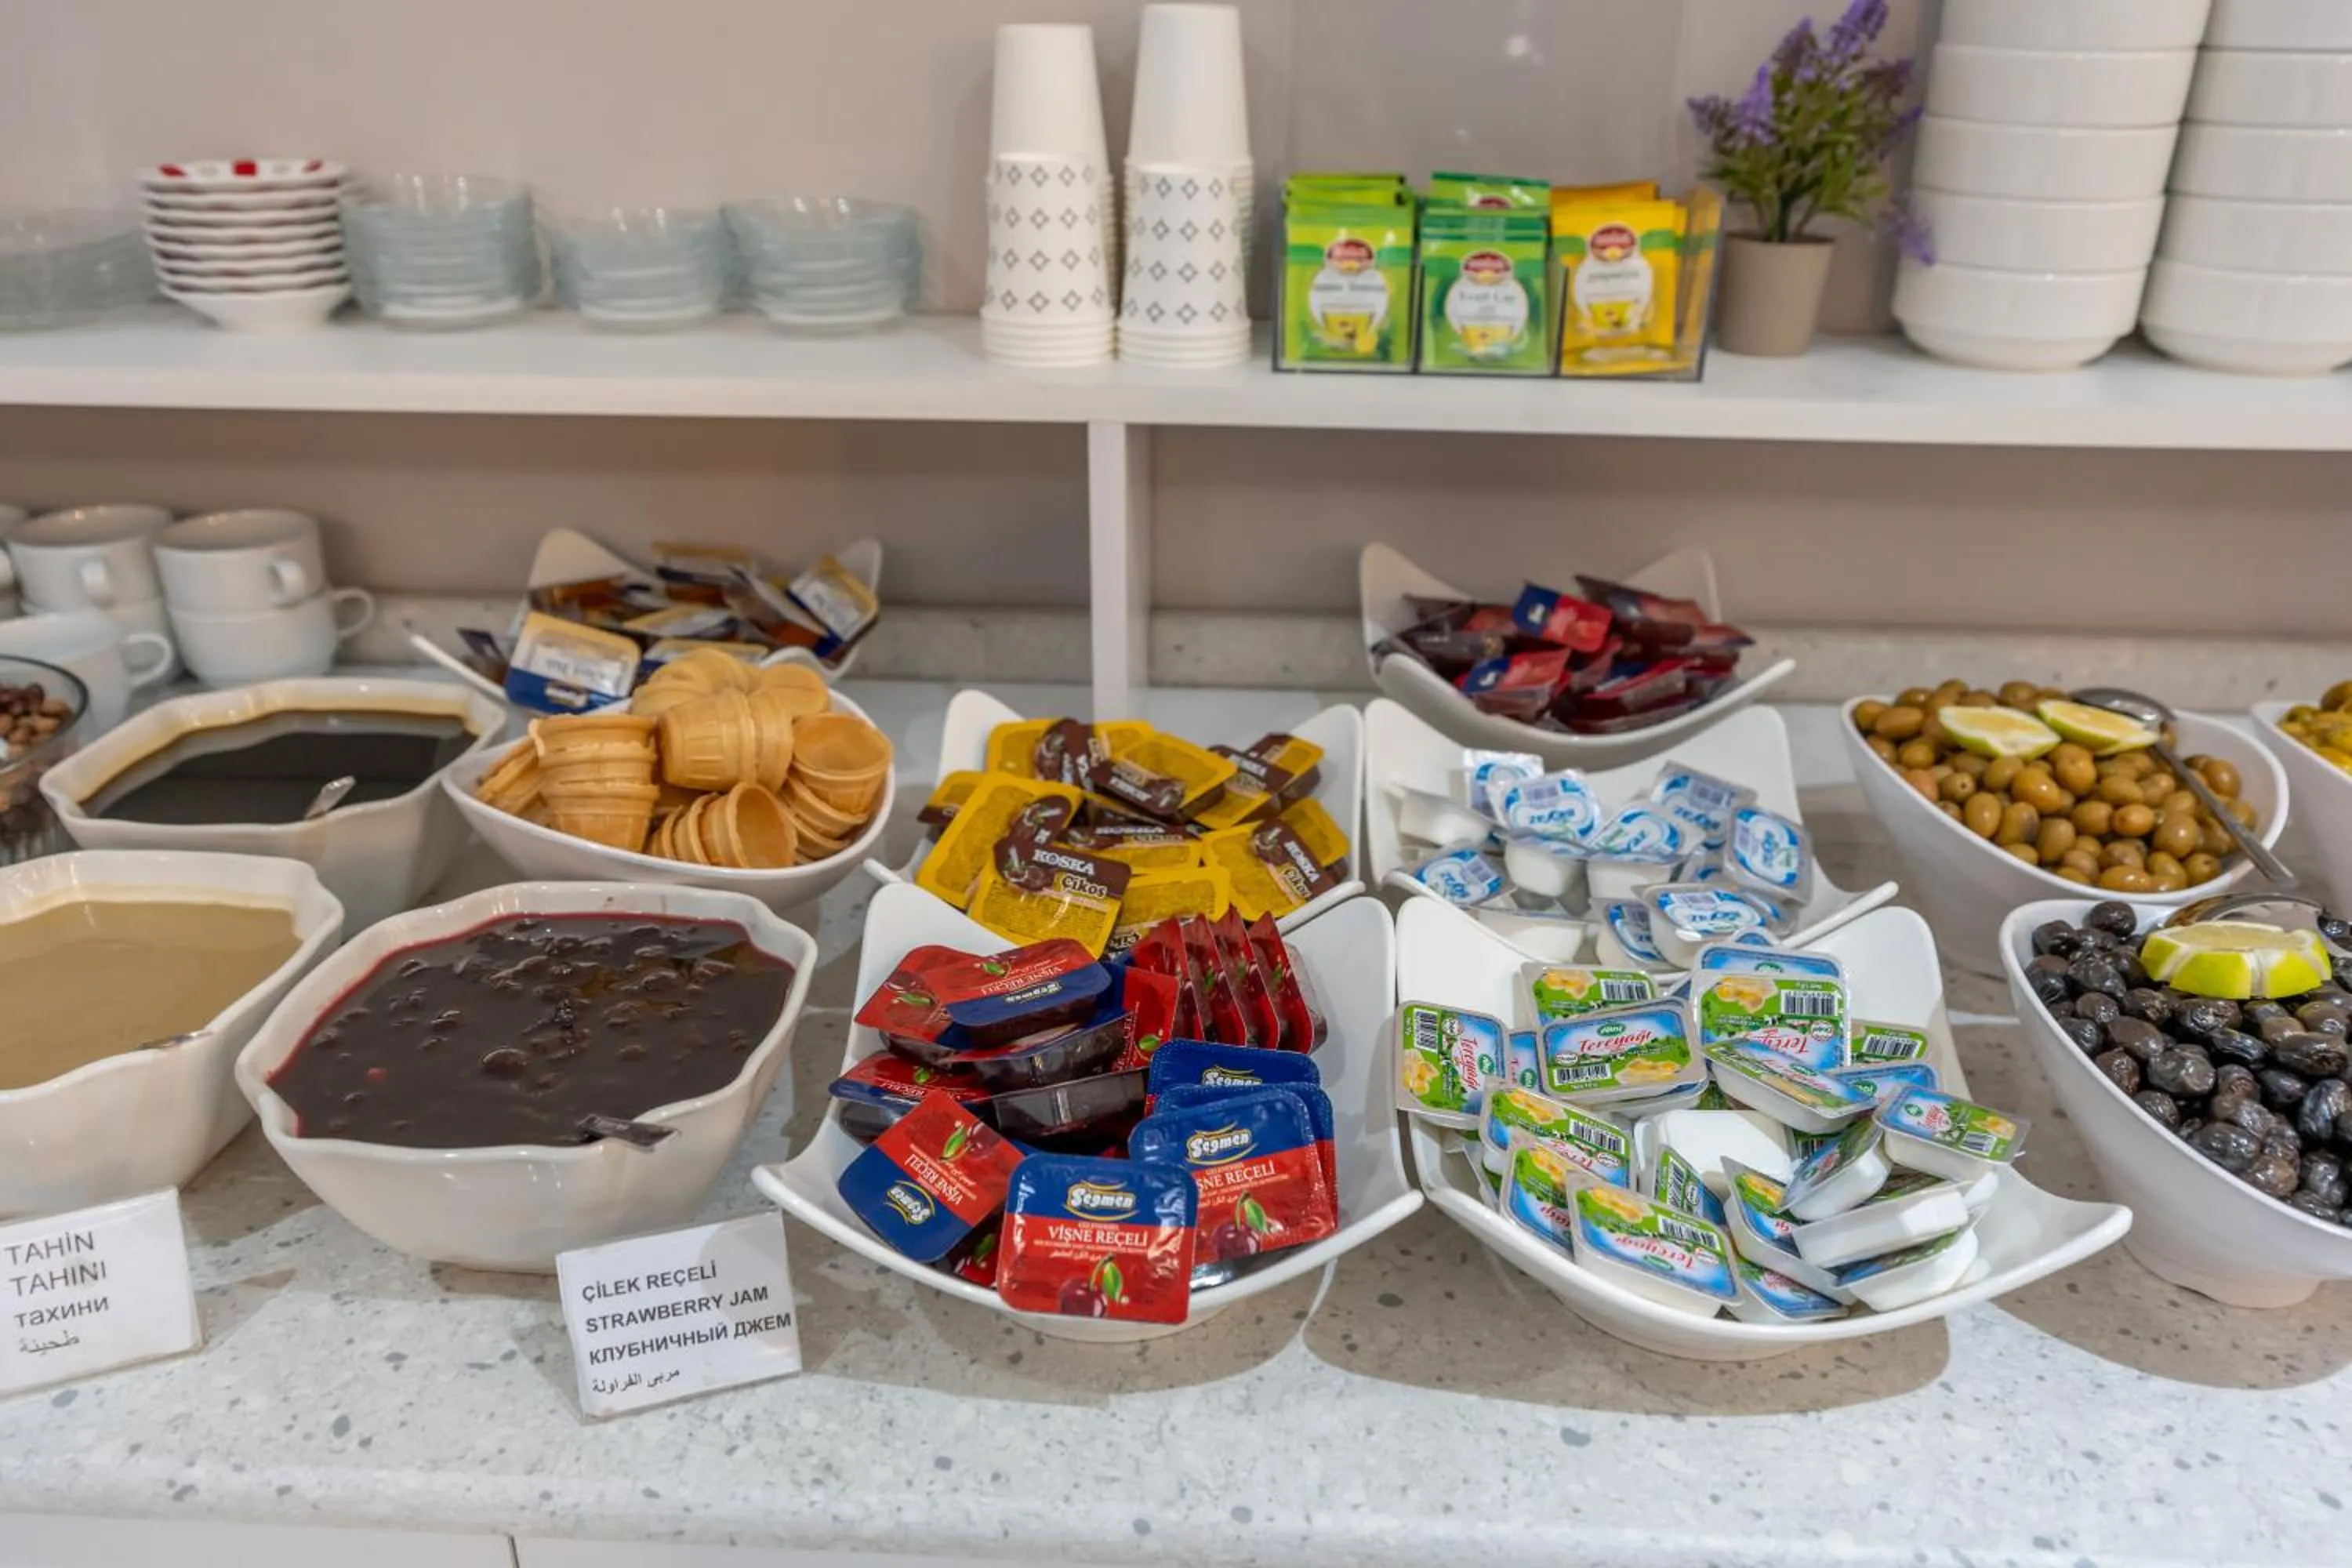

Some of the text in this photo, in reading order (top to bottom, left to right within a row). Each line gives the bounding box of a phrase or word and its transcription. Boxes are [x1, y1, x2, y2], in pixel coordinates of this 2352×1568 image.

[1032, 849, 1096, 876] KOSKA
[1189, 1132, 1251, 1159] Segmen
[1069, 1186, 1135, 1210] Segmen
[4, 1231, 95, 1265] TAHİN
[1047, 1225, 1095, 1243] VİŞNE
[1096, 1229, 1149, 1247] REÇELİ
[582, 1260, 717, 1302] ÇİLEK REÇELİ
[14, 1297, 110, 1328] тахини
[586, 1286, 769, 1334] STRAWBERRY JAM
[589, 1312, 792, 1365] КЛУБНИЧНЫЙ ДЖЕМ
